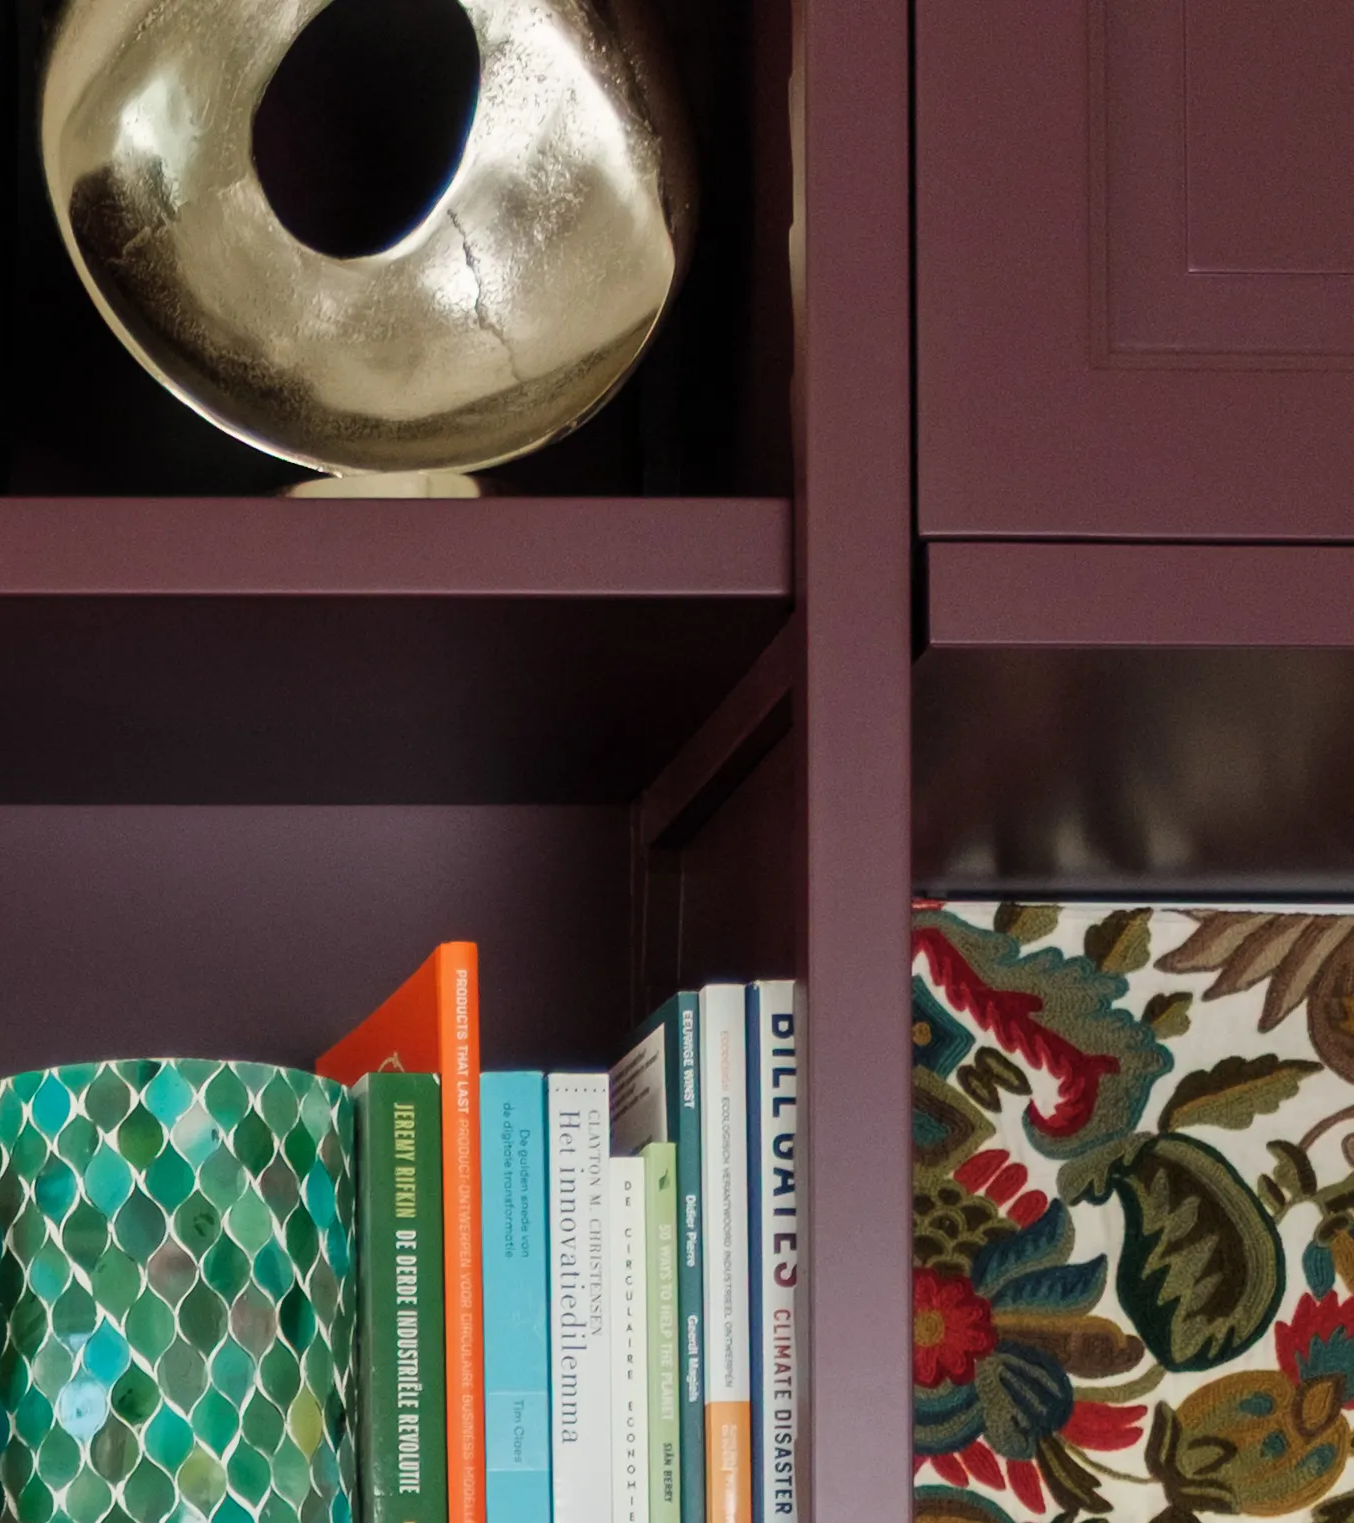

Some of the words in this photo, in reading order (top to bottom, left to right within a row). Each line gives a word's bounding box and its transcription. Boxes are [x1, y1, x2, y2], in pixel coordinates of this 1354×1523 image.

[455, 968, 469, 1040] PRODUCTS
[456, 1043, 469, 1078] THAT
[682, 1009, 695, 1068] EEUWIGE
[683, 1070, 695, 1110] WINST
[771, 1013, 797, 1119] BILL
[457, 1080, 470, 1114] LAST
[502, 1102, 516, 1120] de
[393, 1102, 416, 1163] JEREMY
[501, 1121, 515, 1168] digitale
[519, 1128, 531, 1147] De
[558, 1110, 581, 1154] Het
[588, 1108, 602, 1188] CLAYTON
[721, 1097, 733, 1164] ECOLOGISCH
[394, 1166, 418, 1220] RIFKIN
[517, 1148, 532, 1193] gulden
[624, 1181, 633, 1207] DE
[502, 1169, 516, 1259] transformatie
[520, 1195, 532, 1229] snede
[658, 1223, 672, 1241] 50
[686, 1194, 697, 1229] Didier
[722, 1166, 733, 1248] VERANTWOORD
[772, 1131, 798, 1288] GATES
[395, 1229, 417, 1250] DE
[520, 1231, 532, 1259] van
[659, 1243, 672, 1281] WAYS
[686, 1231, 698, 1268] Pierre
[396, 1255, 418, 1306] DERDE
[459, 1272, 474, 1309] VOOR
[589, 1218, 603, 1336] CHRISTENSEN
[660, 1282, 673, 1300] TO
[723, 1252, 734, 1319] INDUSTRIEEL
[558, 1167, 588, 1444] innovatiedilemma
[624, 1227, 634, 1380] CIRCULAIRE
[660, 1304, 674, 1340] HELP
[396, 1310, 423, 1409] INDUSTRIËLE
[460, 1312, 475, 1390] CIRCULAIRE
[660, 1343, 674, 1369] THE
[724, 1322, 734, 1389] ONTWERPEN
[773, 1308, 792, 1400] CLIMATE
[512, 1399, 525, 1424] Tim
[661, 1371, 675, 1421] PLANET
[461, 1393, 476, 1462] BUSINESS
[512, 1426, 525, 1464] Claes
[398, 1413, 421, 1495] REVOLUTIE
[626, 1400, 637, 1523] ECONOMIE
[773, 1409, 793, 1515] DISASTER
[663, 1470, 674, 1504] BERRY
